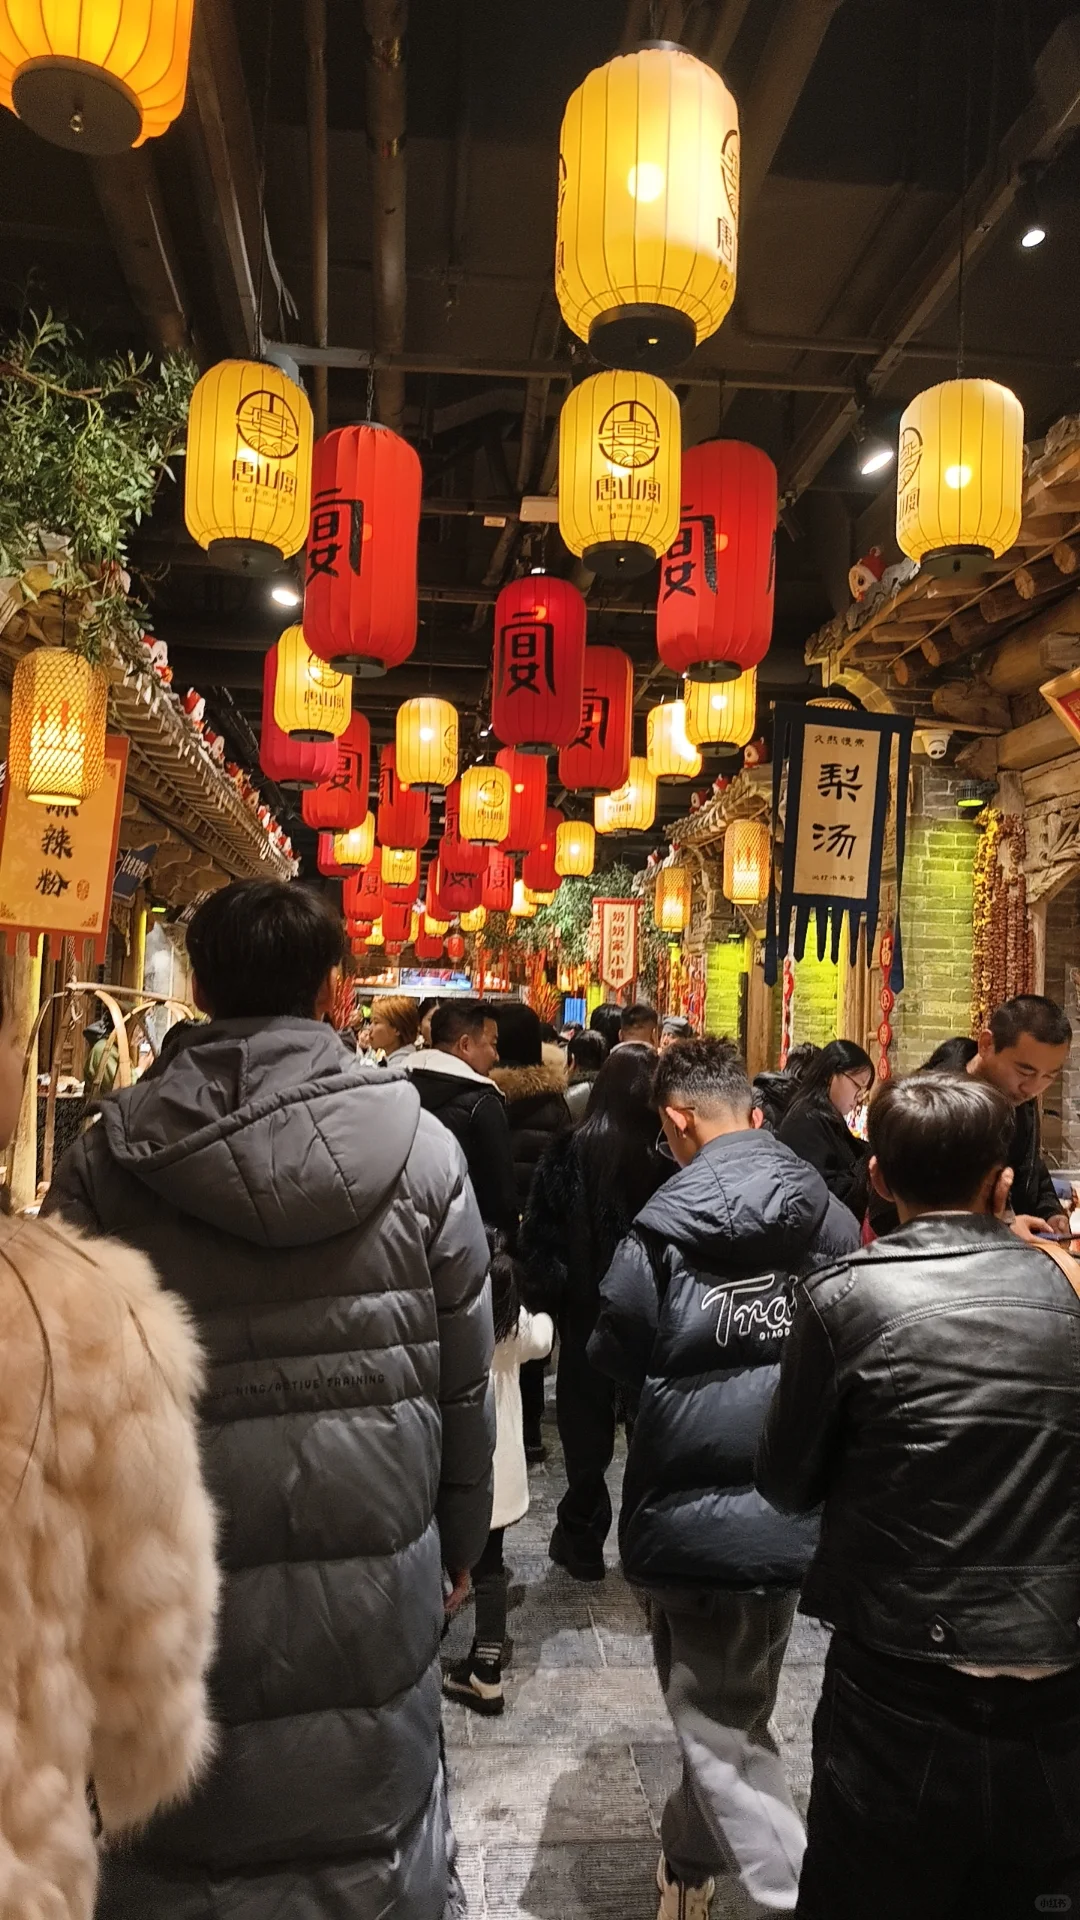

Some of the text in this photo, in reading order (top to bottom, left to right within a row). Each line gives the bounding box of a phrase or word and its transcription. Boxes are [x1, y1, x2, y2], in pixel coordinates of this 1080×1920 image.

[596, 474, 661, 504] 唐山宴
[496, 611, 557, 697] 宴
[812, 763, 863, 860] 梨汤
[327, 1374, 386, 1388] TRAINING
